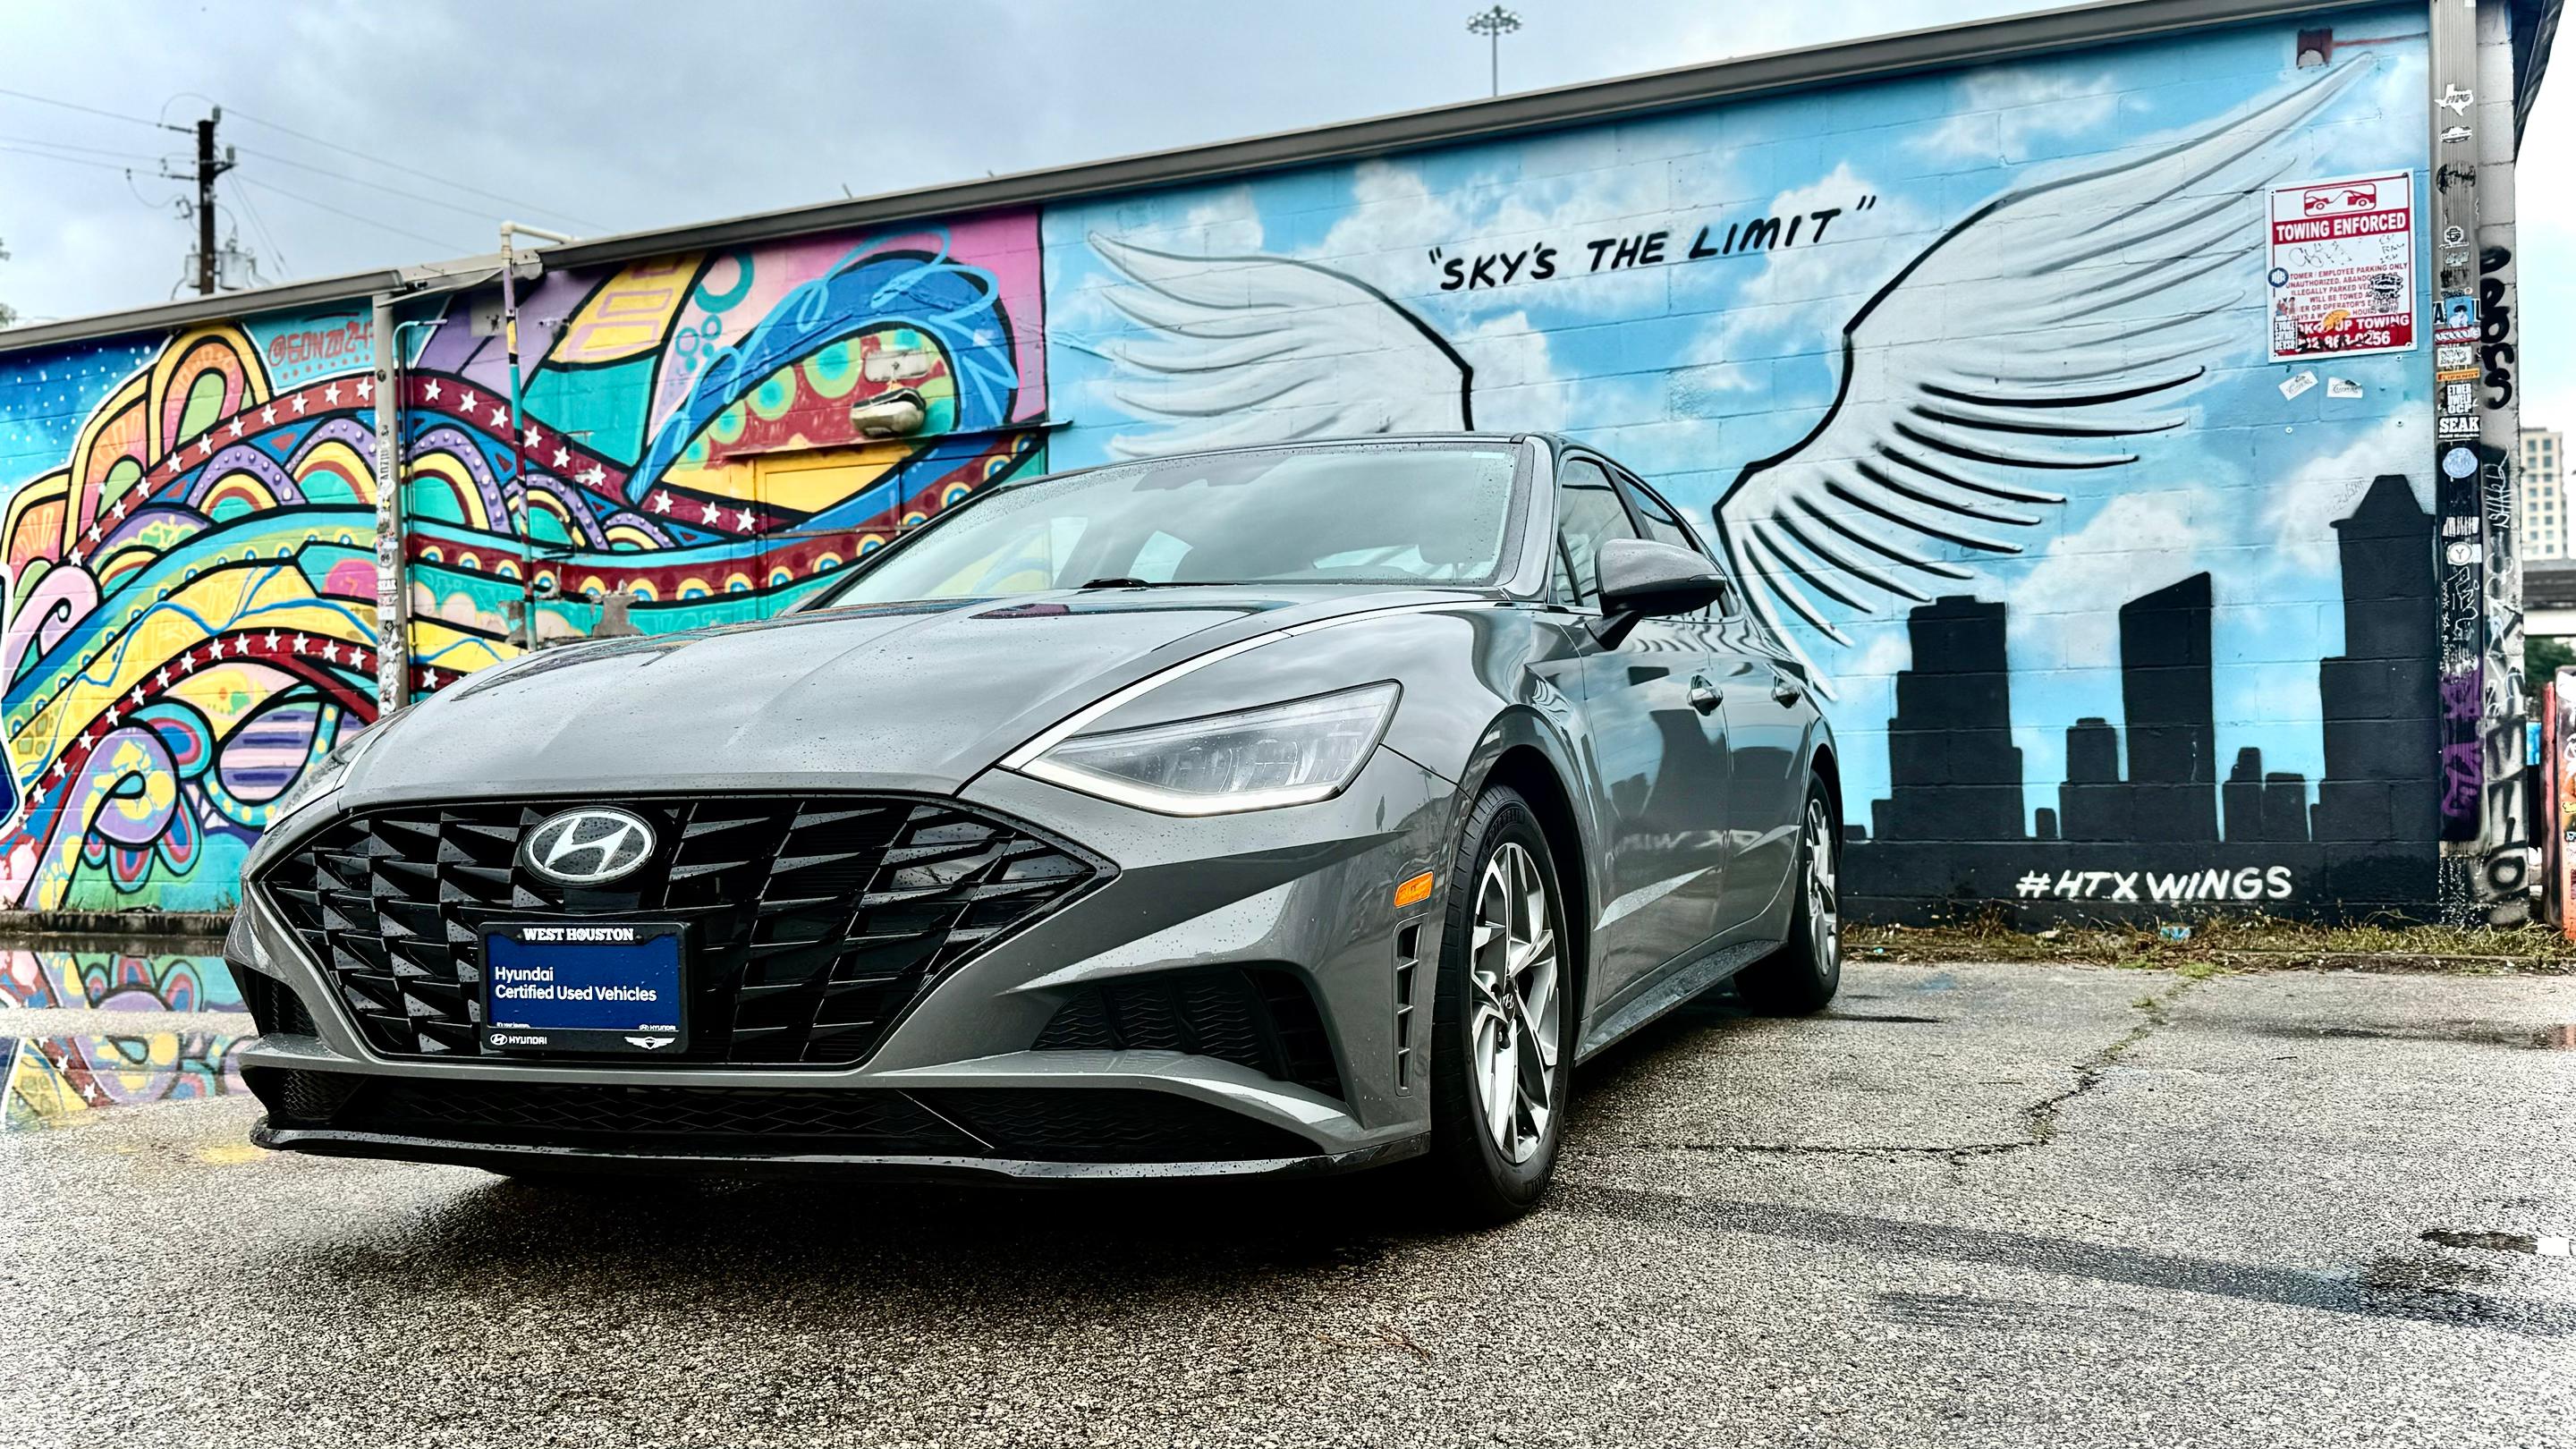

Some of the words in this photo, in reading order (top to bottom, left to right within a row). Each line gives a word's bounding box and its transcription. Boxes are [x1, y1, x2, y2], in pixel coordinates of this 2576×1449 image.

[2276, 220, 2330, 242] TOWING
[2334, 212, 2406, 236] ENFORCED
[1587, 231, 1669, 273] THE
[2290, 272, 2312, 280] TOMER
[2318, 267, 2354, 277] EMPLOYEE
[2357, 264, 2387, 274] PARKING
[2389, 262, 2408, 271] ONLY
[2291, 287, 2326, 296] ILLEGALLY
[2329, 284, 2359, 292] PARKED
[2309, 295, 2326, 303] WILL
[2340, 292, 2362, 301] TOWED
[2323, 300, 2366, 310] OPERATOR'S
[2356, 315, 2410, 329] TOWING
[2439, 417, 2479, 433] SEAK
[523, 928, 565, 941] WEST
[566, 928, 634, 941] HOUSTON
[495, 966, 554, 984] Hyundai
[495, 984, 555, 1000] Certified
[556, 987, 593, 1000] Used
[596, 987, 657, 1002] Vehicles
[508, 1036, 547, 1045] HYUNDAI
